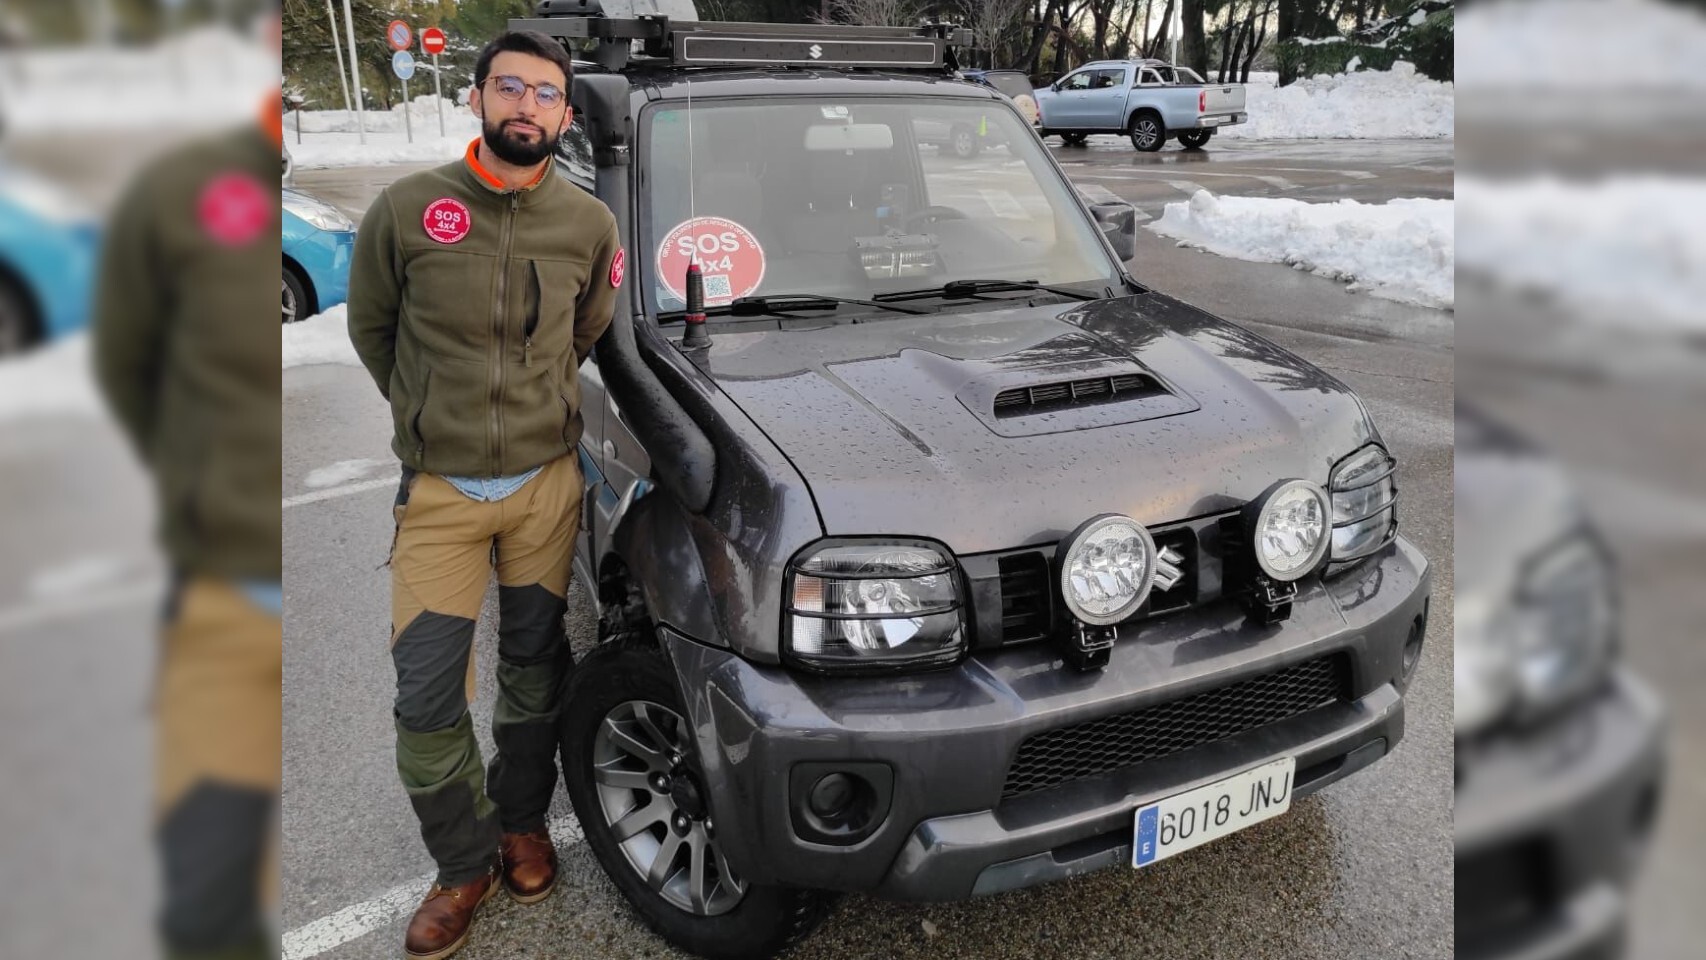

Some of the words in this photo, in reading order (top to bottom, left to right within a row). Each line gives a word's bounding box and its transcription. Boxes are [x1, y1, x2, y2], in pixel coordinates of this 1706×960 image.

[435, 210, 461, 223] SOS
[437, 220, 455, 230] 4x4
[677, 232, 740, 257] SOS
[1160, 794, 1231, 846] 6018
[1240, 771, 1290, 817] JNJ
[1143, 842, 1150, 854] E
